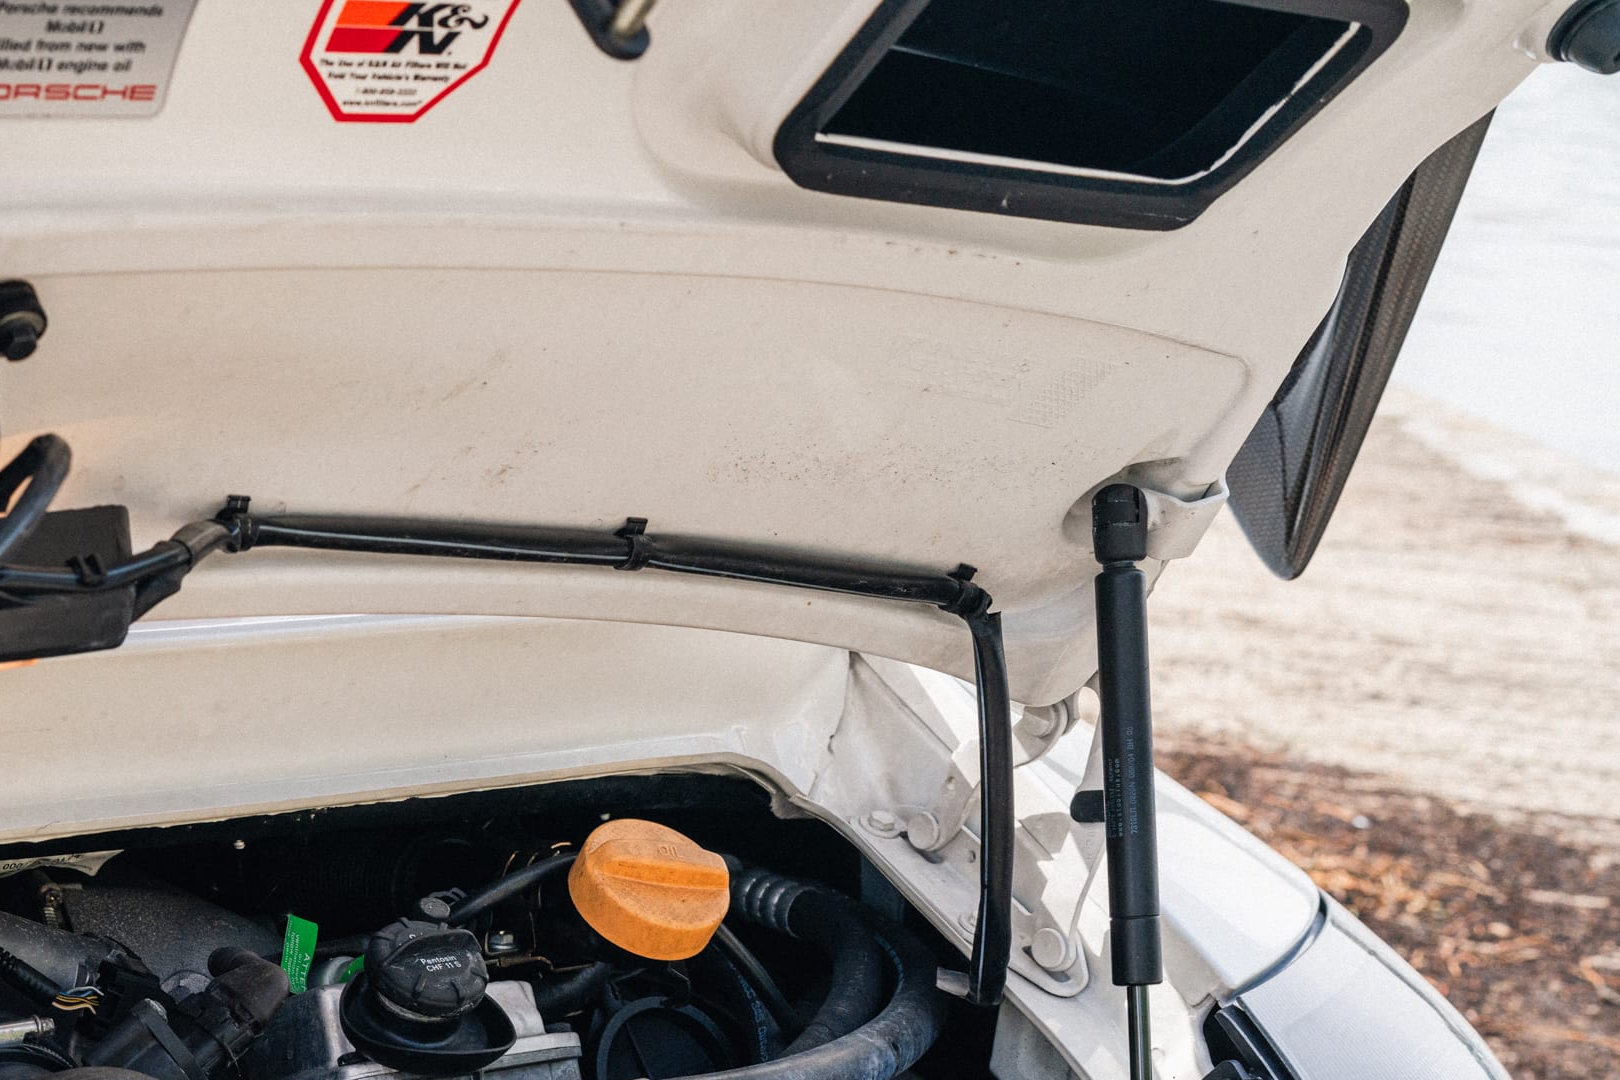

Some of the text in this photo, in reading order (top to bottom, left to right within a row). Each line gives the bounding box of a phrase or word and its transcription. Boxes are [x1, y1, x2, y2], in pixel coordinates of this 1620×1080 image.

[36, 40, 71, 52] from
[76, 43, 108, 52] new
[113, 41, 146, 53] with
[57, 60, 108, 74] engine
[112, 60, 133, 73] oil
[420, 954, 458, 966] Pentosin
[426, 963, 444, 973] CHF
